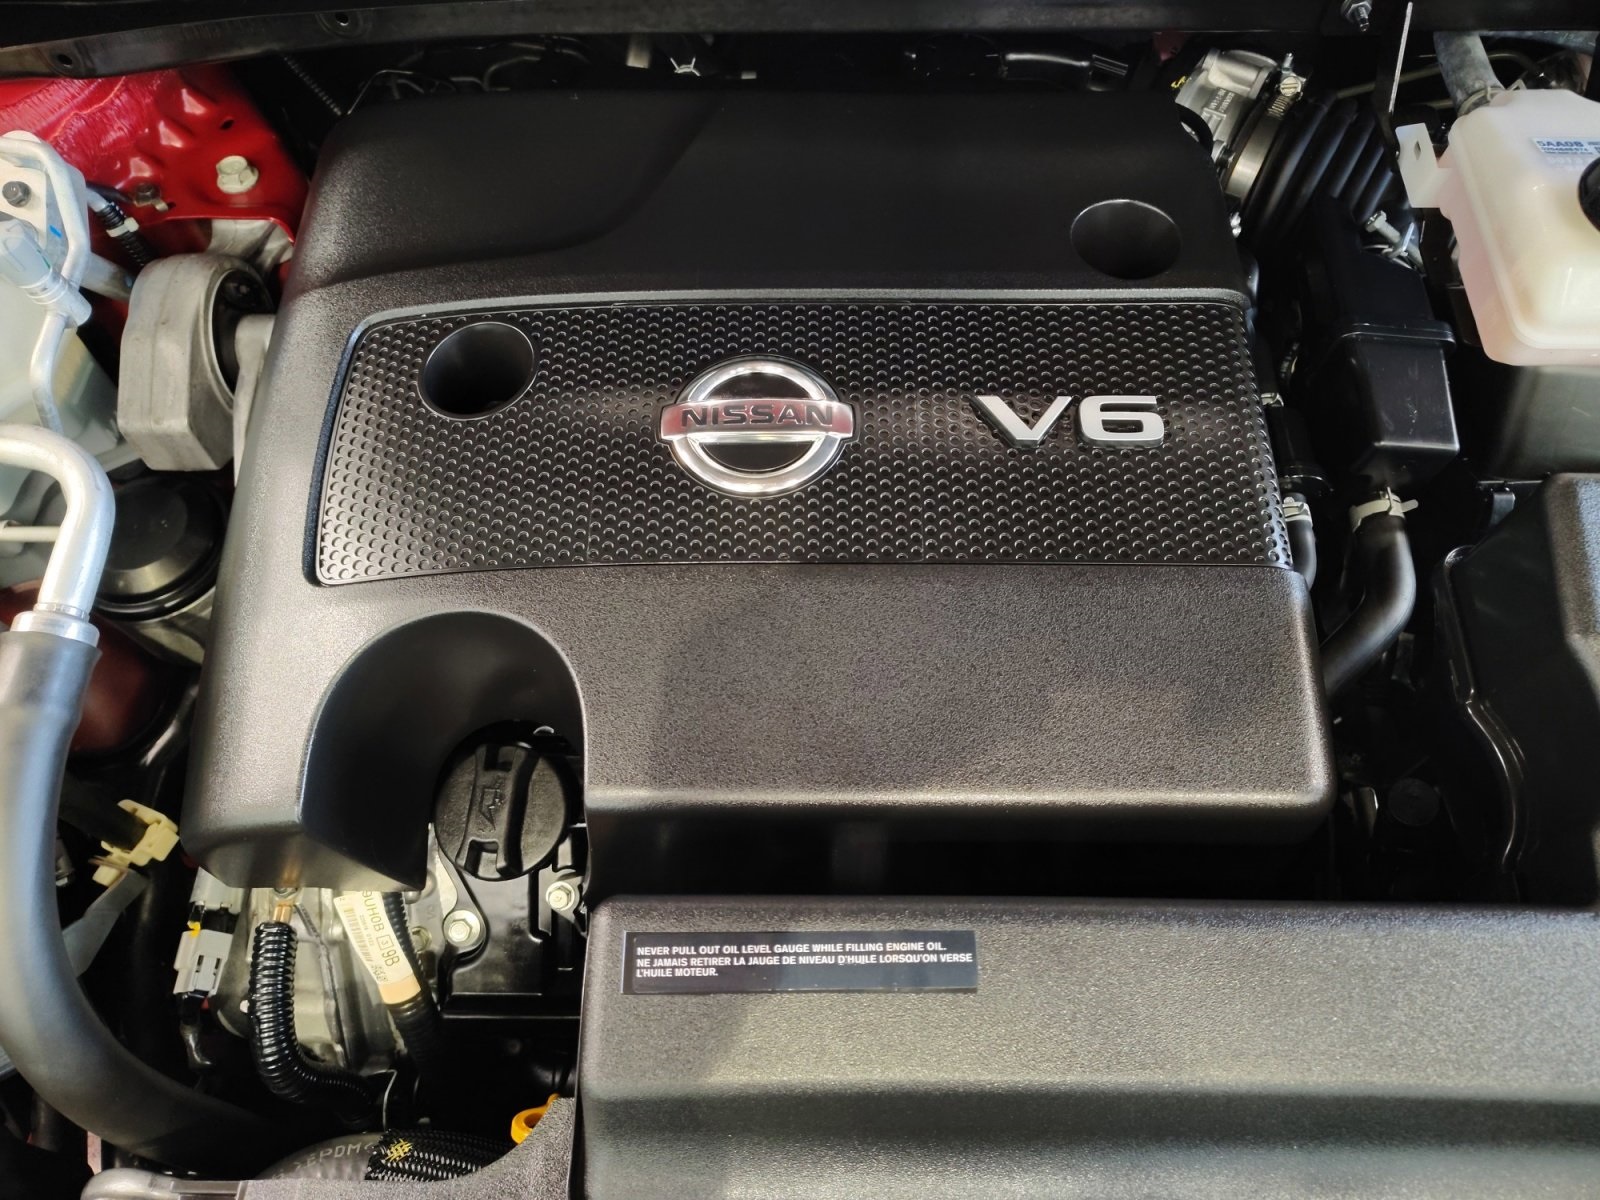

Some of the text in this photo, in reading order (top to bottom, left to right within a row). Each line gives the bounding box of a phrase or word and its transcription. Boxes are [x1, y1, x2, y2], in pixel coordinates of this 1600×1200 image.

[681, 403, 833, 428] NISSAN
[976, 395, 1165, 447] V6
[636, 941, 947, 956] NEVER PULL OUT OIL LEVEL GAUGE WHILE FILLING ENGINE OIL.
[636, 952, 973, 967] NE JAMAIS RETIRER LA JAUGE DE NIVEAU D'HUILE LORSQU'ON VERSE
[636, 967, 719, 978] L'HUILE MOTEUR.
